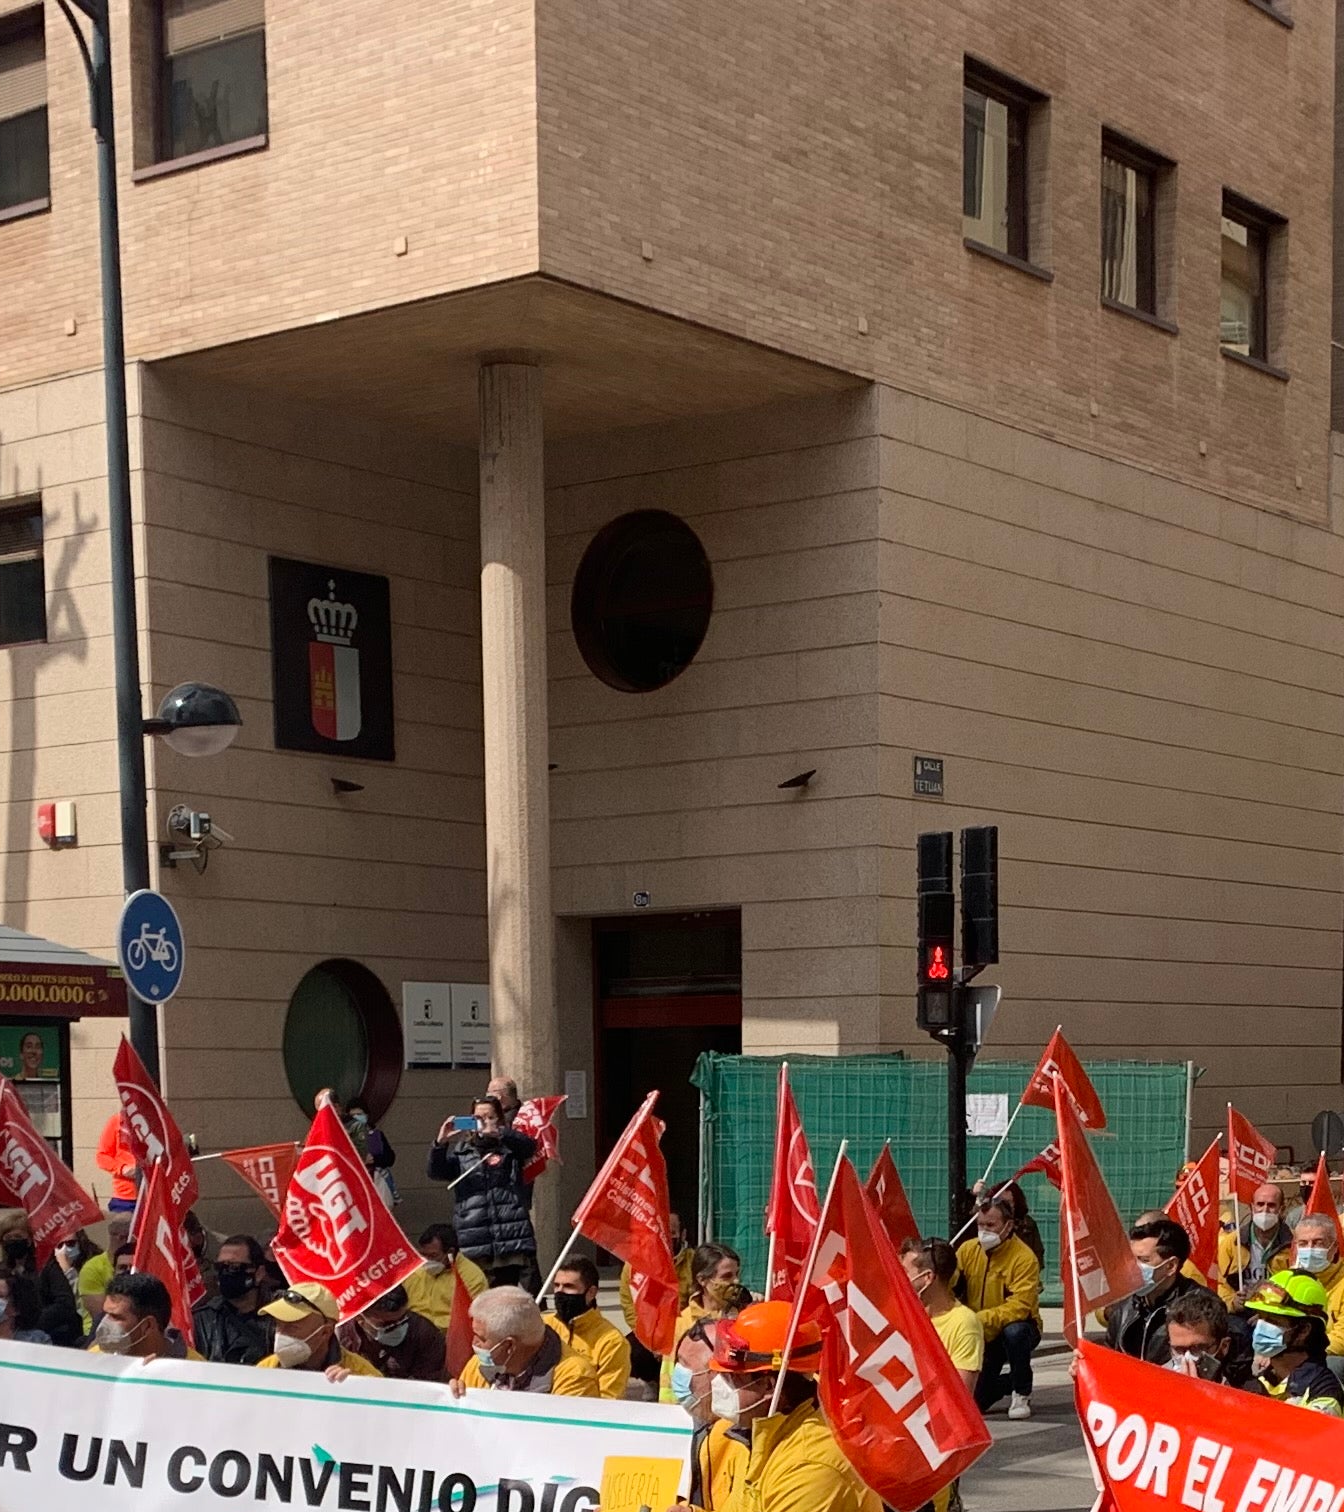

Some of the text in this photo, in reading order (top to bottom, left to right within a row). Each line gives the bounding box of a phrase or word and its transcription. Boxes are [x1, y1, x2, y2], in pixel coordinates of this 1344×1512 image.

[294, 1154, 368, 1246] UGT
[58, 1433, 148, 1489] UN
[1087, 1400, 1181, 1497] POR
